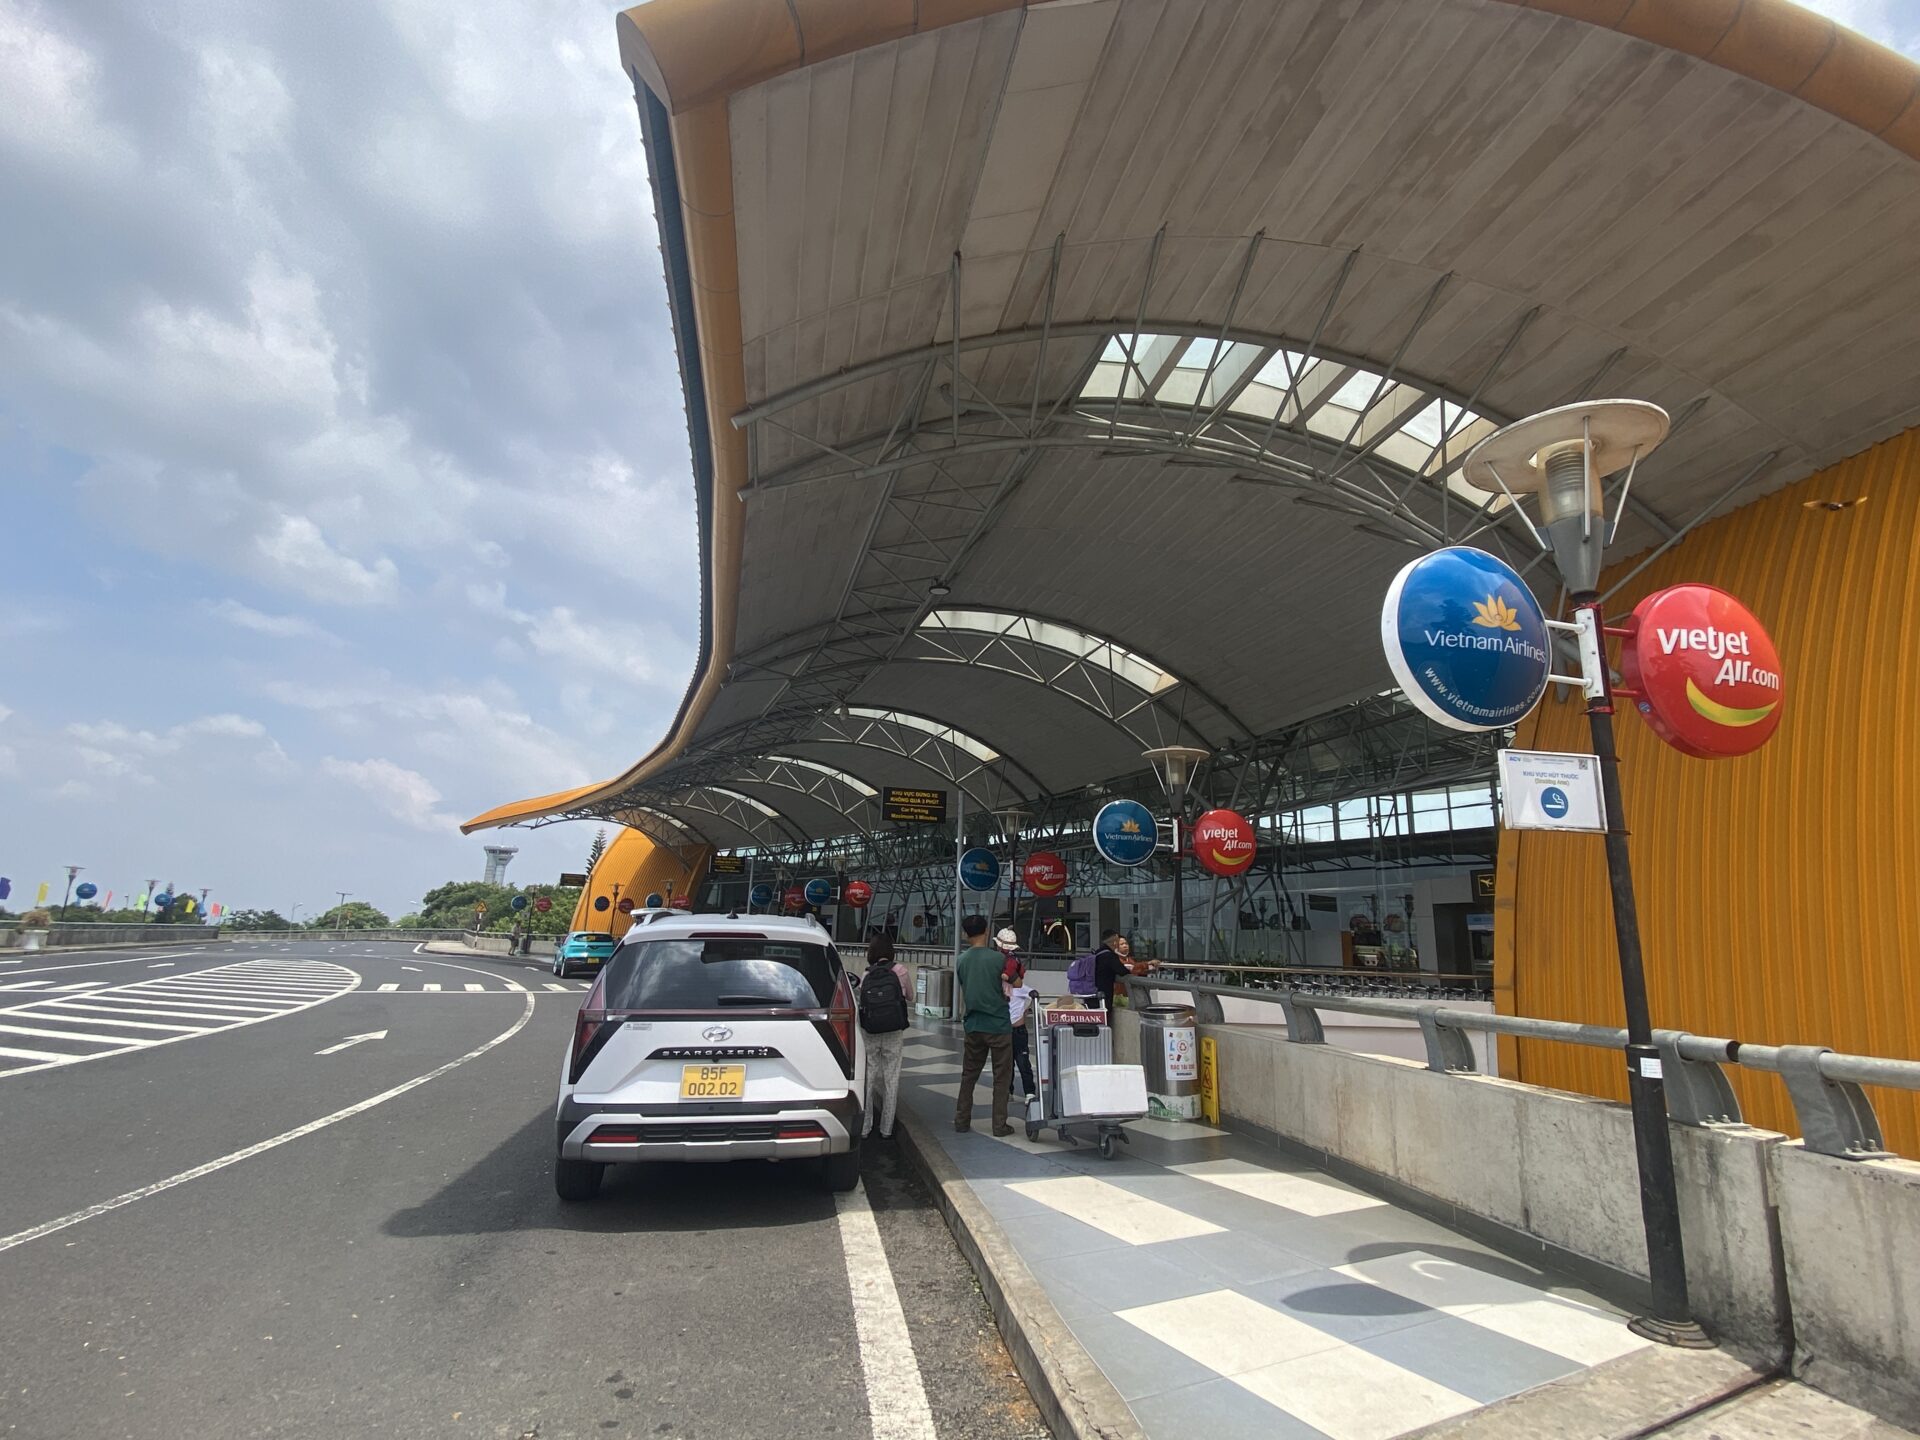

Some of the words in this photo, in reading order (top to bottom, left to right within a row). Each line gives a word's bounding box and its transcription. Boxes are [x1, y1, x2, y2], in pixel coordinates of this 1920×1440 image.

[1424, 630, 1503, 652] Vietnam
[1503, 636, 1547, 664] Airlines
[1424, 666, 1542, 718] www.vietnamairlines.com
[1104, 832, 1133, 841] Vietnam
[1133, 834, 1153, 843] Airlines
[1060, 1014, 1102, 1023] AGRIBANK
[701, 1067, 728, 1080] 85F
[688, 1082, 737, 1096] 002.02
